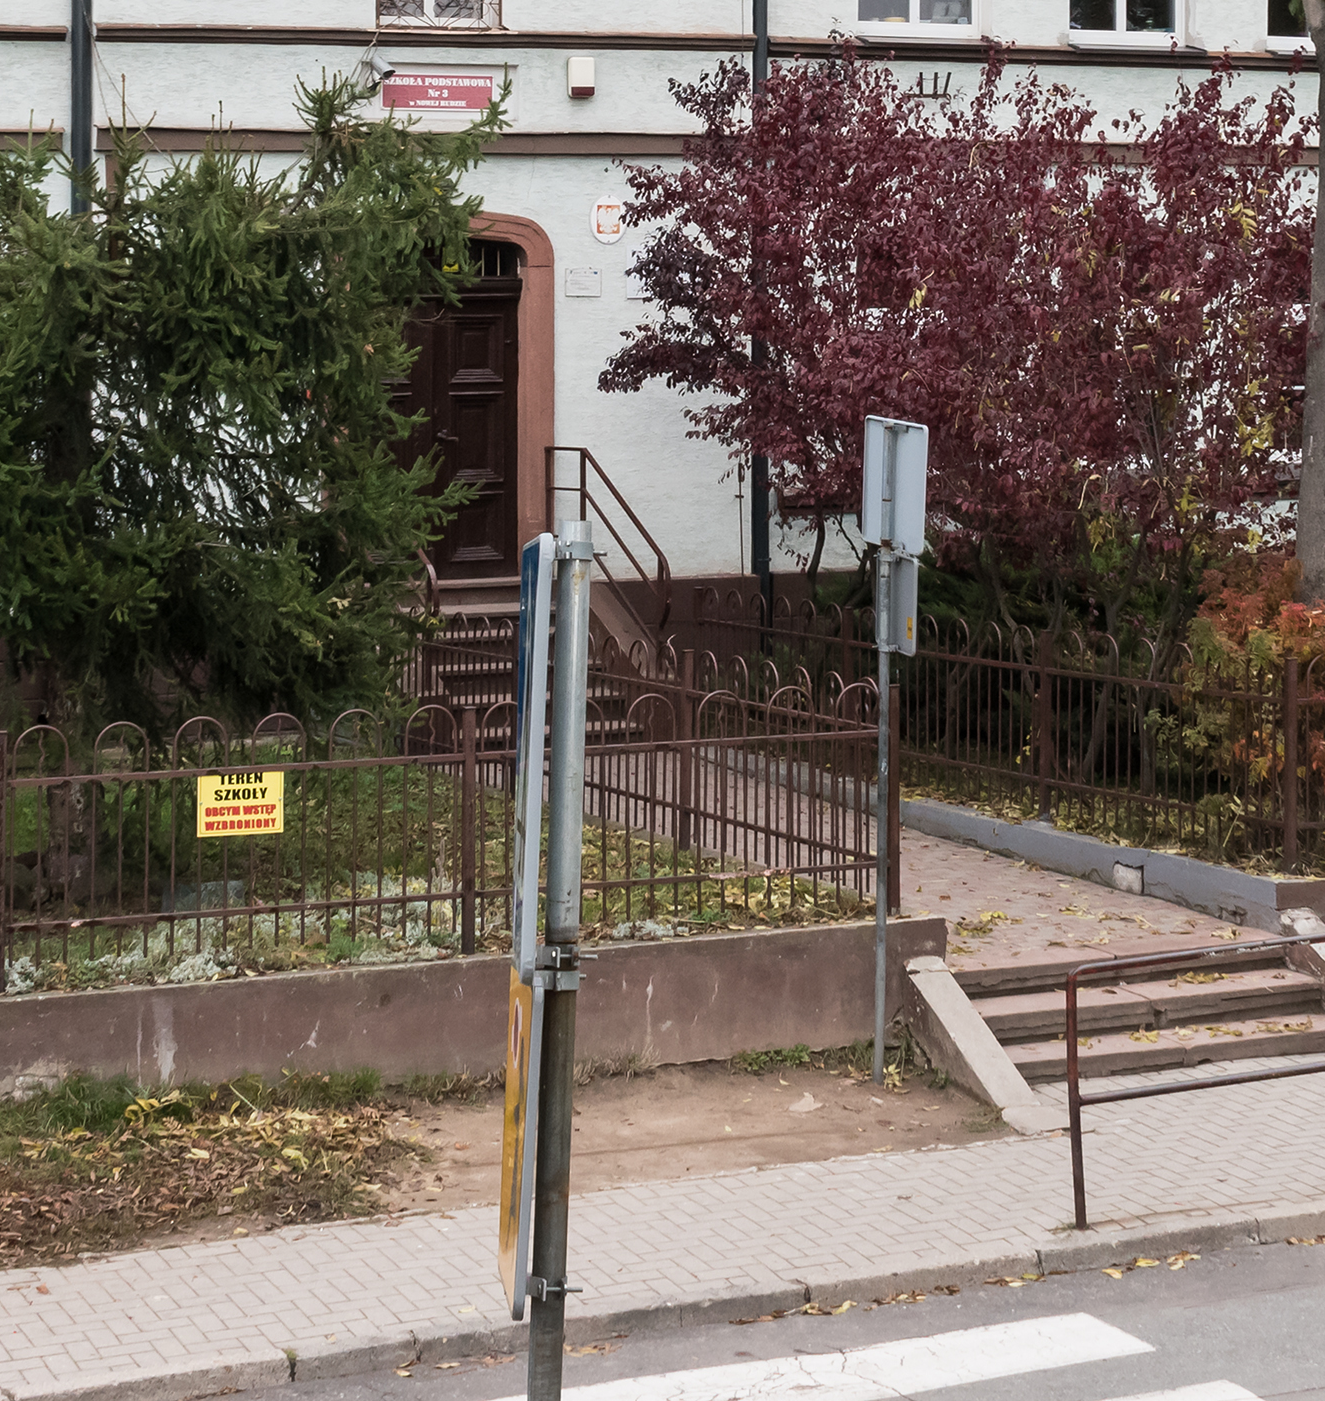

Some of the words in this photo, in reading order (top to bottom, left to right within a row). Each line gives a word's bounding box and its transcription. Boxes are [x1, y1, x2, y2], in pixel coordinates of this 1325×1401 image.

[384, 77, 422, 86] SZKOŁA
[425, 78, 491, 87] PODSTAWOWA
[427, 89, 440, 97] Nr
[442, 89, 449, 98] 3
[220, 772, 263, 785] TEREN
[214, 787, 268, 801] SZKOŁY
[205, 806, 240, 817] OBCYM
[243, 804, 276, 815] WSTĘP
[205, 818, 276, 831] WZBRONIONY
